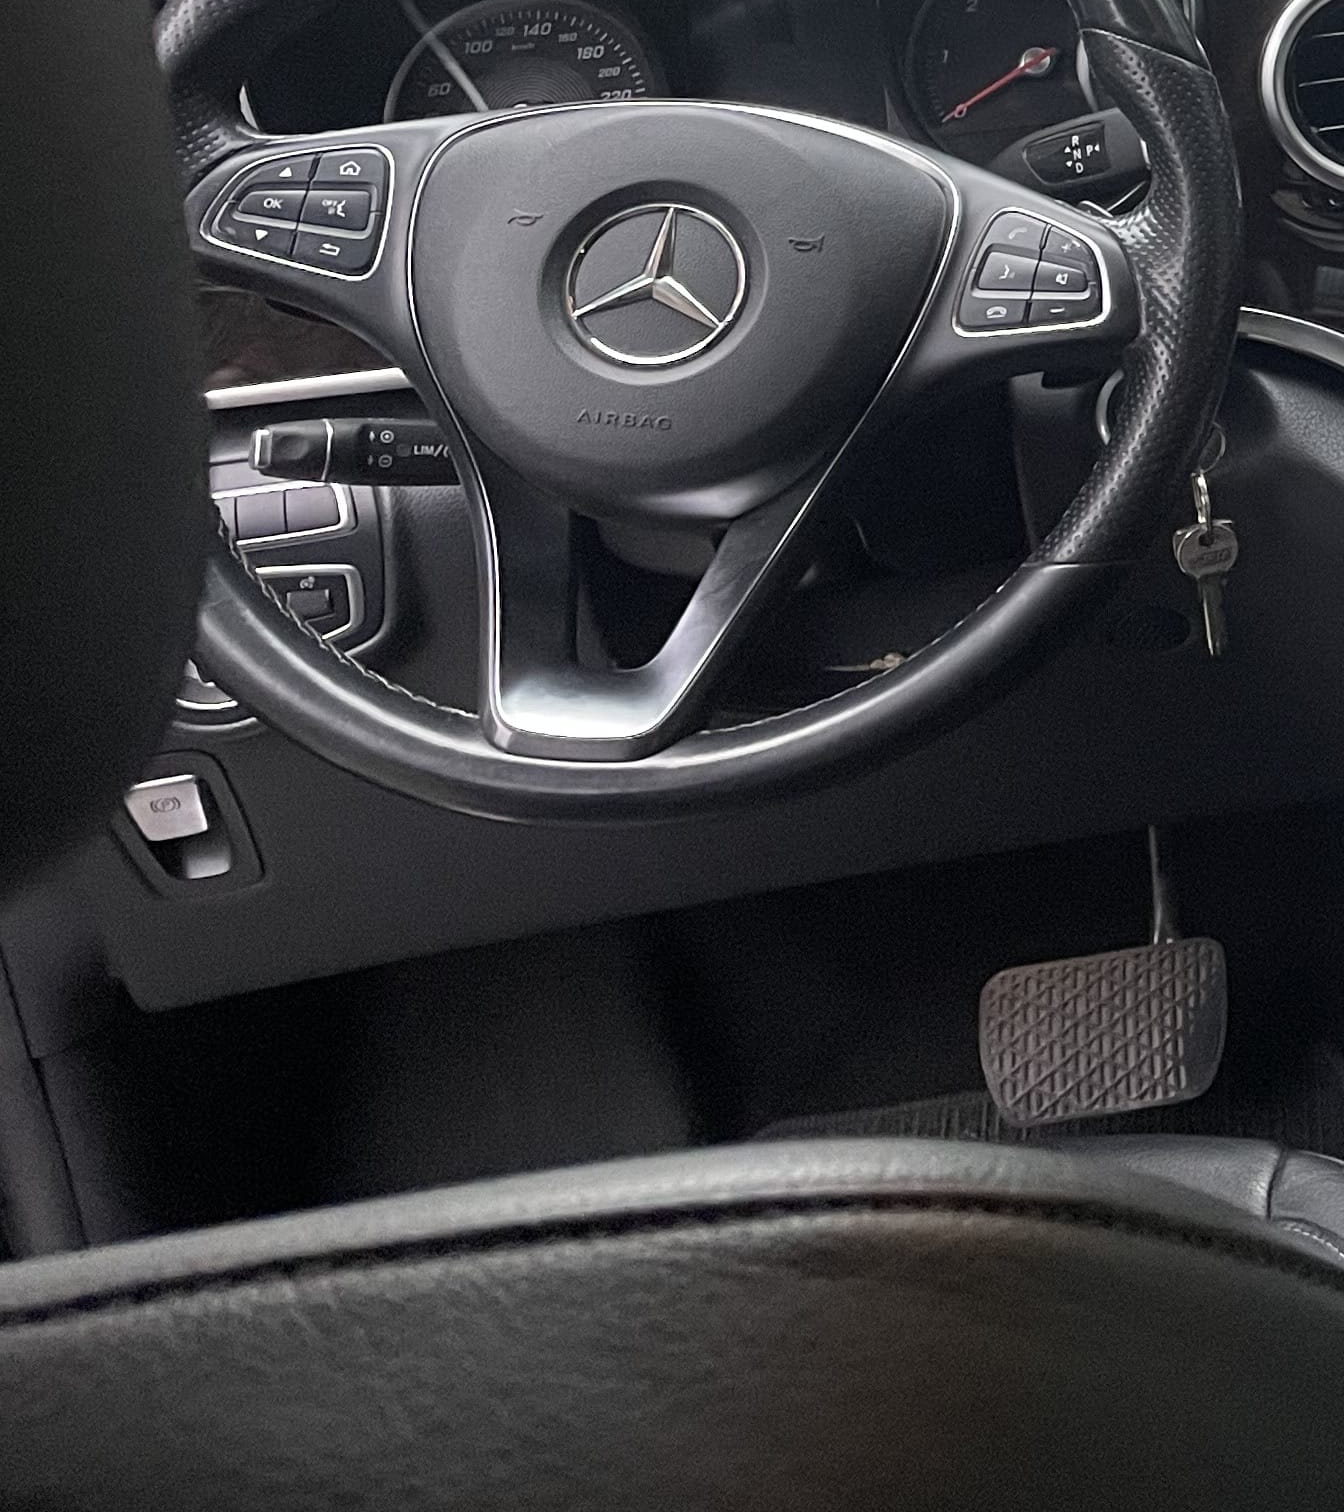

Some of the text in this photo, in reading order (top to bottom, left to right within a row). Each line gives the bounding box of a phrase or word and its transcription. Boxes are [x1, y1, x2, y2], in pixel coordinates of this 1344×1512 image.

[523, 22, 552, 37] 140
[464, 40, 493, 54] 100
[576, 45, 605, 60] 180
[1071, 135, 1080, 147] R
[1073, 144, 1094, 160] N P
[1075, 161, 1084, 174] D
[263, 197, 284, 210] OK
[576, 408, 673, 431] AIRBAG
